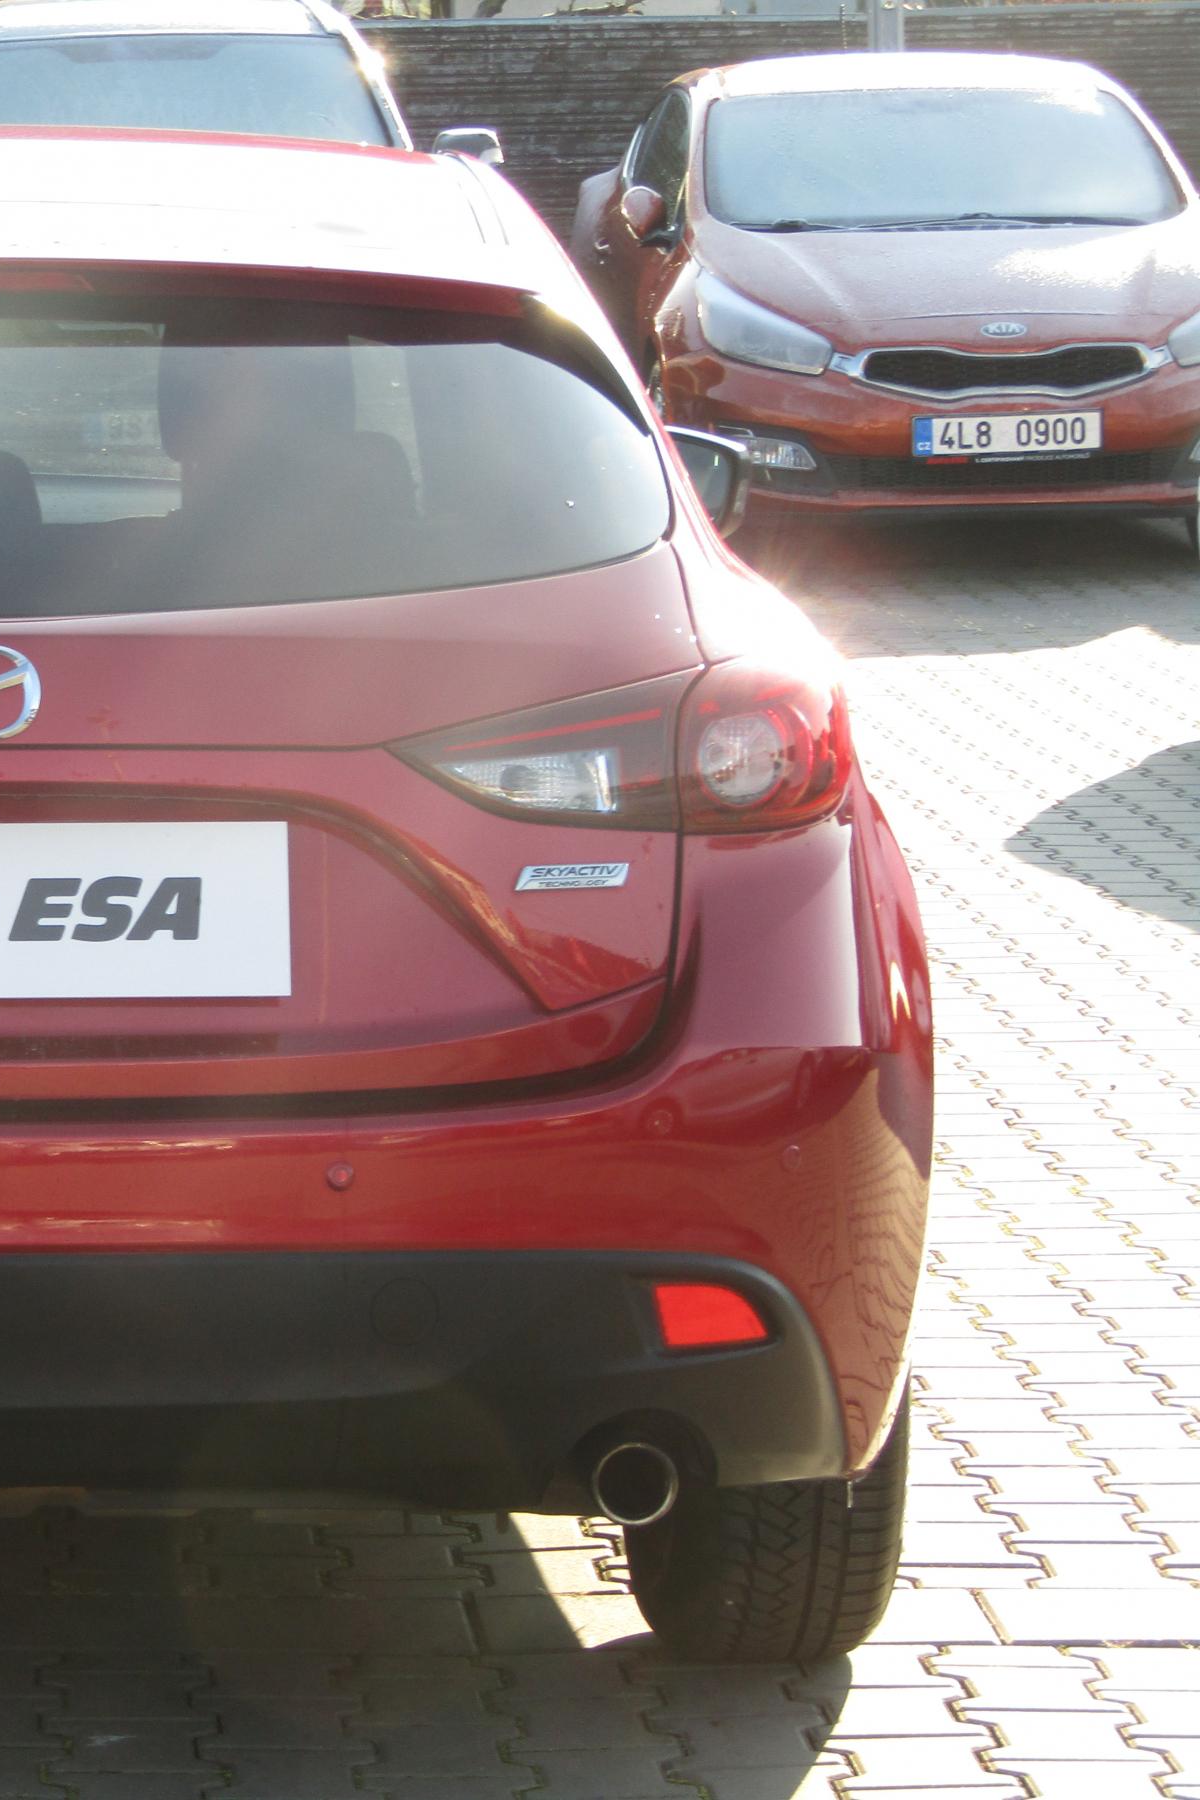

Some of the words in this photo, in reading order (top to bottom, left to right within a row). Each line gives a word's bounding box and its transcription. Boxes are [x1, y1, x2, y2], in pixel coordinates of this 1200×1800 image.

[988, 321, 1021, 334] KIA
[939, 421, 992, 449] 4L8
[1015, 416, 1086, 446] 0900
[916, 441, 931, 451] CZ
[530, 865, 619, 878] SKYACTIV
[538, 879, 609, 888] TECHNOOGY
[7, 875, 203, 943] ESA
